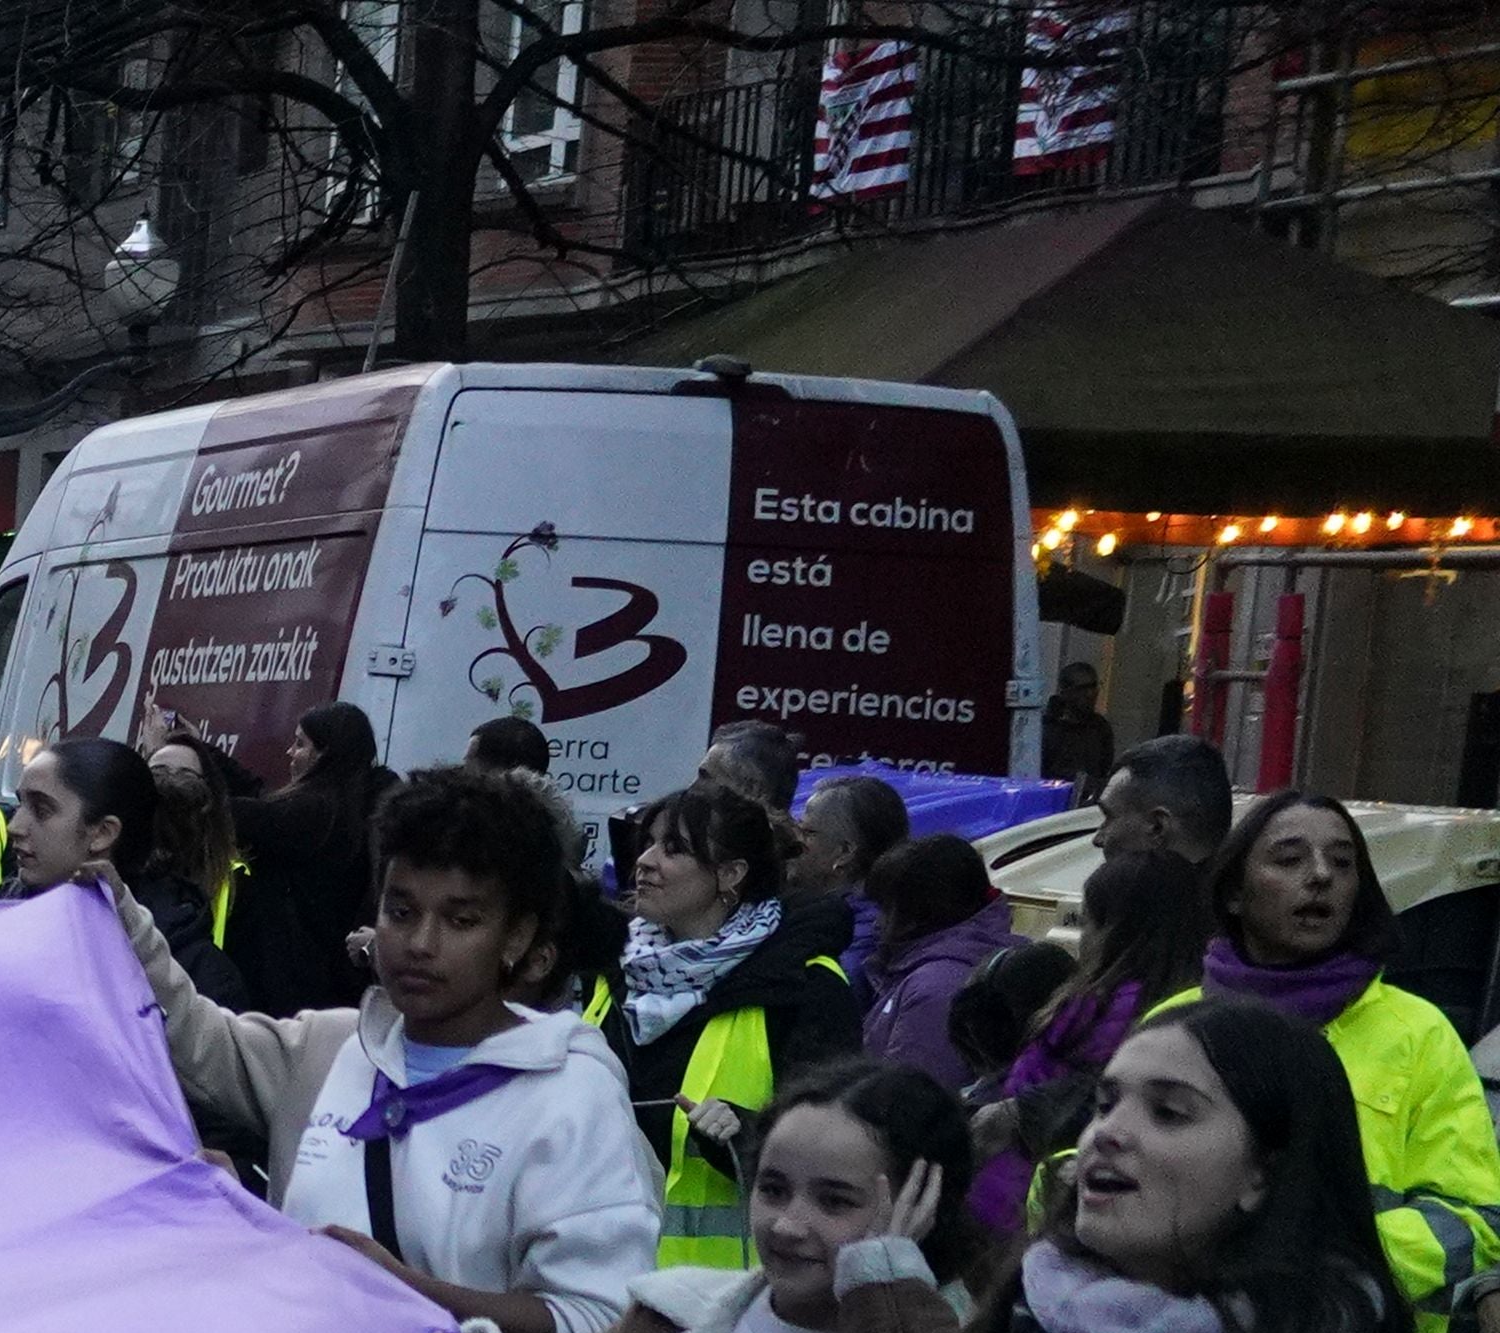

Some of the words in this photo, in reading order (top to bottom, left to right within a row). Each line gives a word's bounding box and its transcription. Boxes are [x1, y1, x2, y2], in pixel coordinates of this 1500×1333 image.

[191, 450, 301, 517] Gourmet?
[753, 487, 841, 524] Esta
[849, 496, 974, 534] cabina
[169, 547, 264, 600] Produktu
[263, 540, 321, 590] onak
[746, 554, 833, 587] está
[742, 613, 834, 651] llena
[842, 621, 892, 655] de
[146, 636, 248, 698] gustatzen
[245, 626, 319, 682] zaizkit
[736, 684, 976, 723] experiencias
[547, 738, 609, 760] erra
[548, 769, 641, 794] oarte
[450, 1138, 503, 1181] 35
